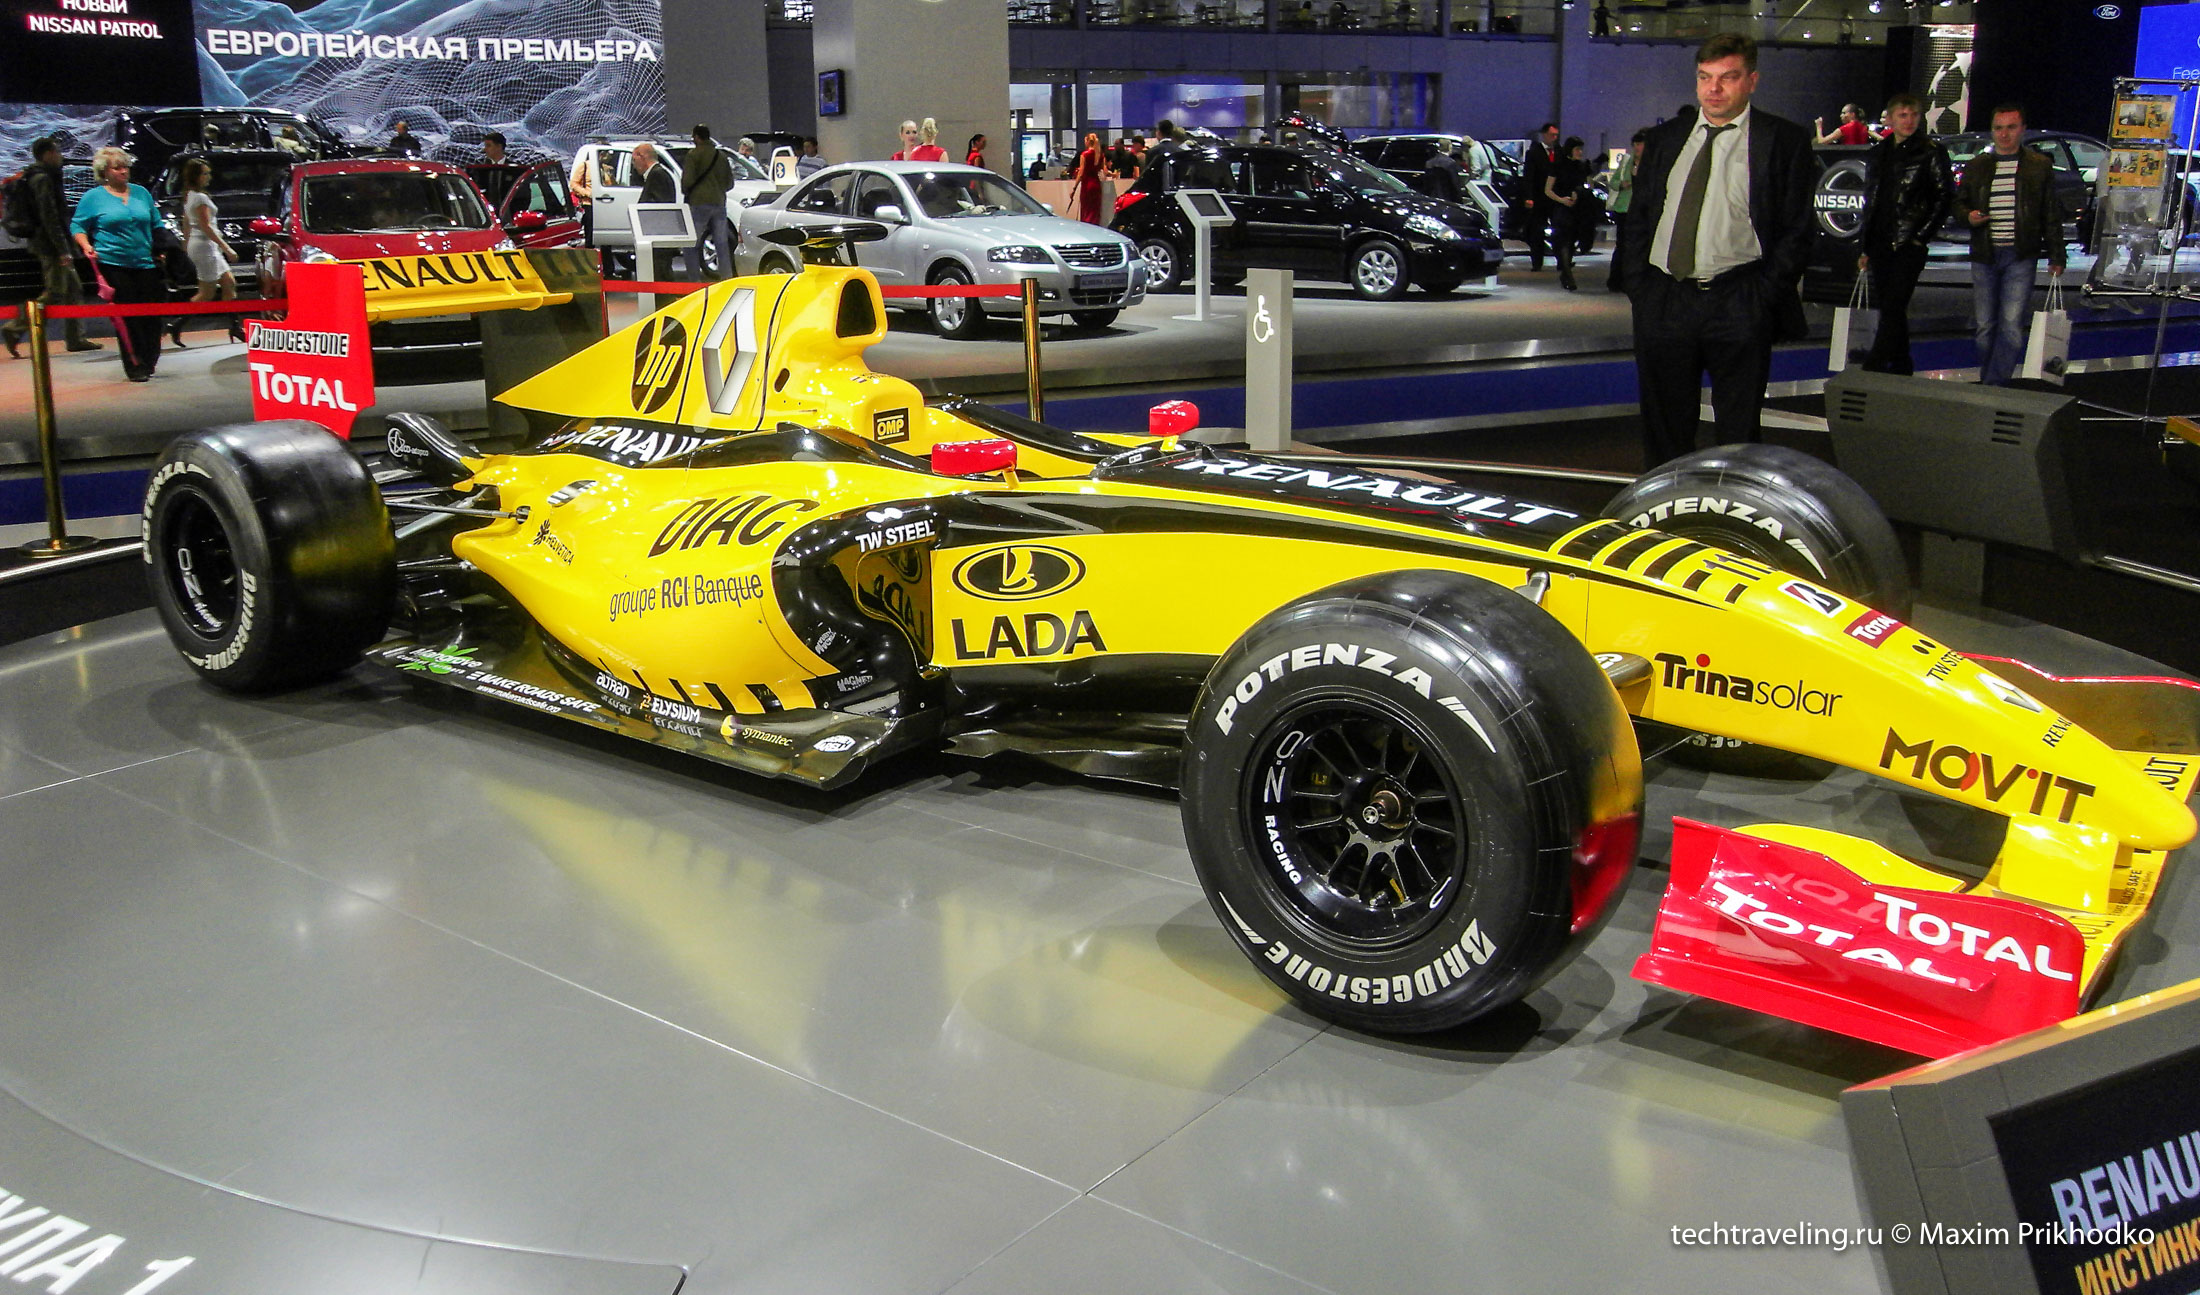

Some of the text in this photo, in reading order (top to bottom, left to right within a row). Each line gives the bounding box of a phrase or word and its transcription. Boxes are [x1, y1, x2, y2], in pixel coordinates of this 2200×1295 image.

[28, 15, 163, 39] NISSAN PATROL
[206, 29, 657, 63] ЕВРОПЕЙСКАЯ ПРЕМЬЕРА
[249, 323, 349, 357] BRIDGESTONE
[250, 362, 357, 411] TOTAL
[877, 419, 904, 436] OMP
[142, 461, 188, 564] POTENZA
[1174, 458, 1578, 525] RENAULT
[648, 495, 820, 558] DIAC
[855, 518, 936, 553] TW STEEL
[1629, 496, 1783, 541] OTENZA
[545, 533, 575, 566] HELVETICA
[609, 573, 764, 623] groupe RCI Banque
[952, 610, 1108, 660] LADA
[478, 673, 519, 690] MAKE
[514, 683, 564, 702] ROADS
[559, 695, 602, 713] SAFE
[1214, 642, 1434, 737] POTENZA
[1926, 661, 1952, 682] TW
[651, 696, 701, 724] ELYSIUM
[742, 726, 793, 747] symantec
[1265, 814, 1303, 886] RACING
[1873, 891, 2073, 981] TOTAL
[1264, 917, 1497, 1006] BRIDGESTONE
[2050, 1130, 2200, 1244] RENAU
